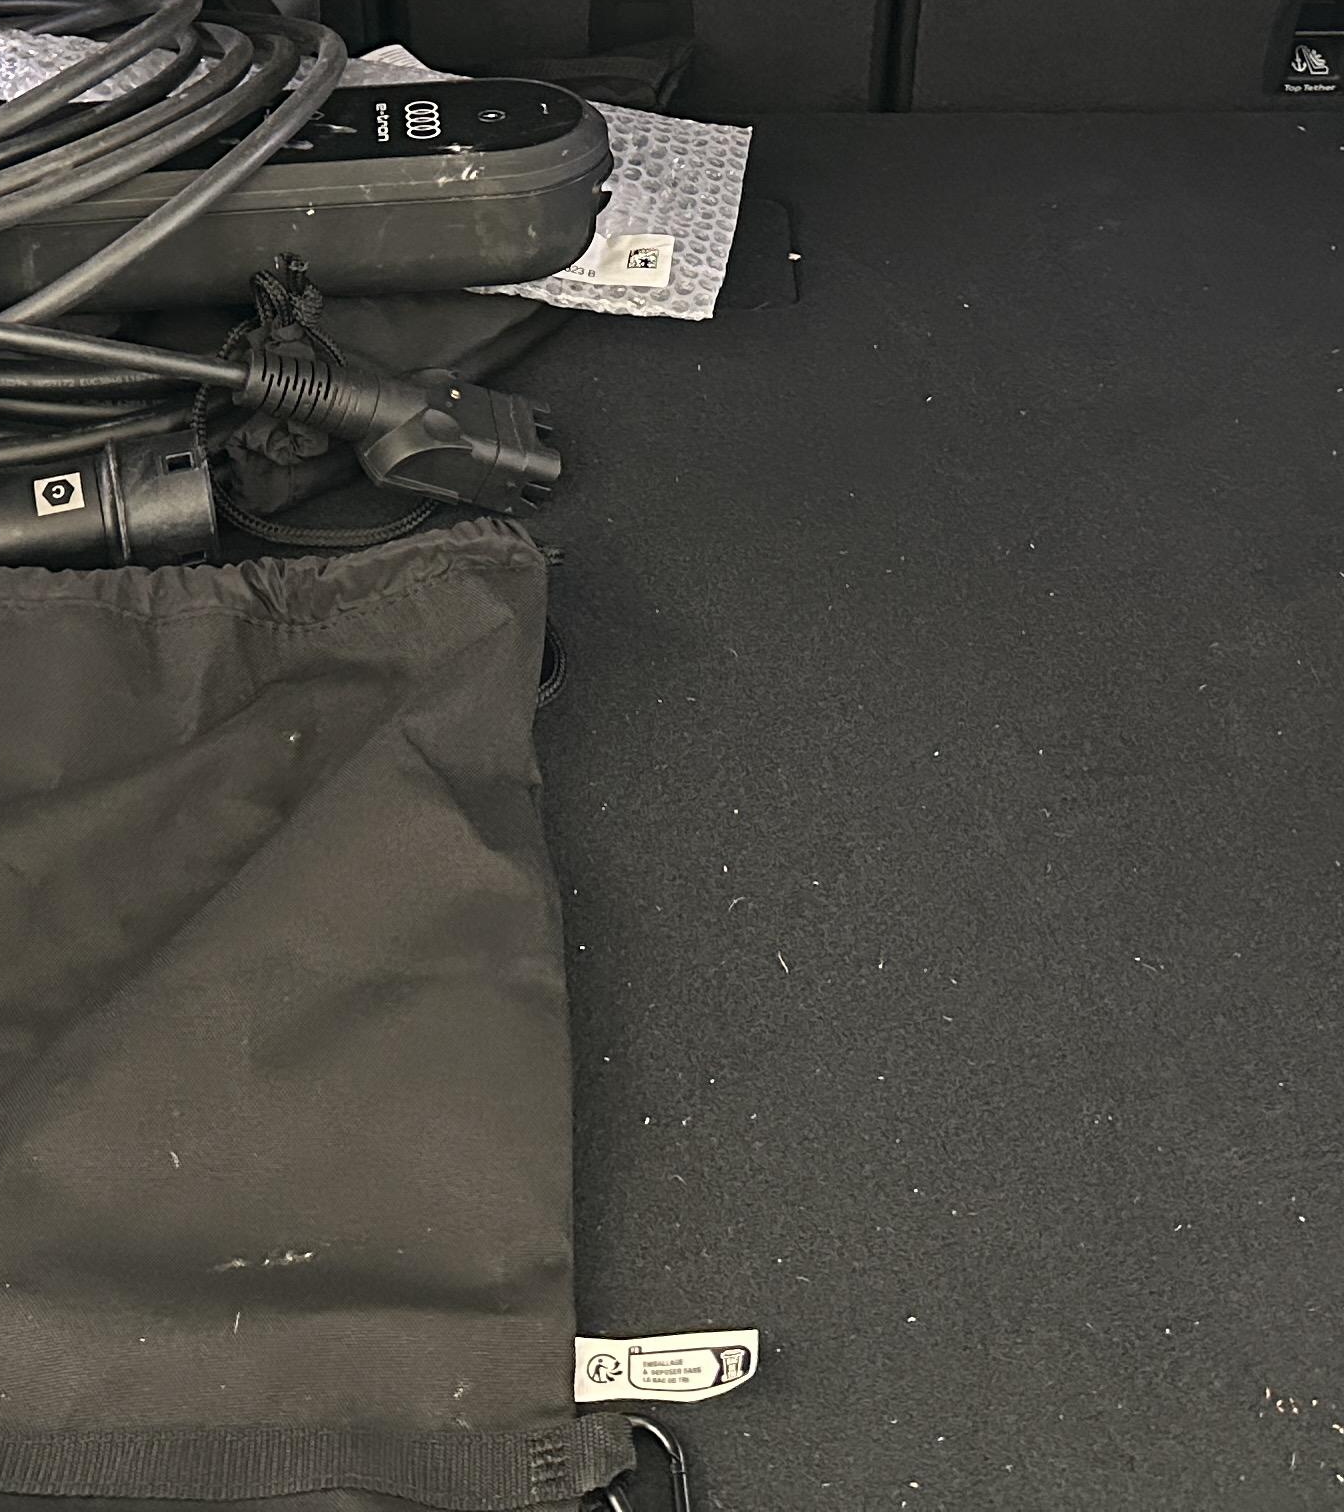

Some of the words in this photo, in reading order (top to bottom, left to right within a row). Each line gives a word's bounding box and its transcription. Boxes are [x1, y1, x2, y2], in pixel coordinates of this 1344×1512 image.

[1284, 84, 1303, 92] Top
[1304, 84, 1336, 92] Tether
[375, 103, 390, 142] e-tron
